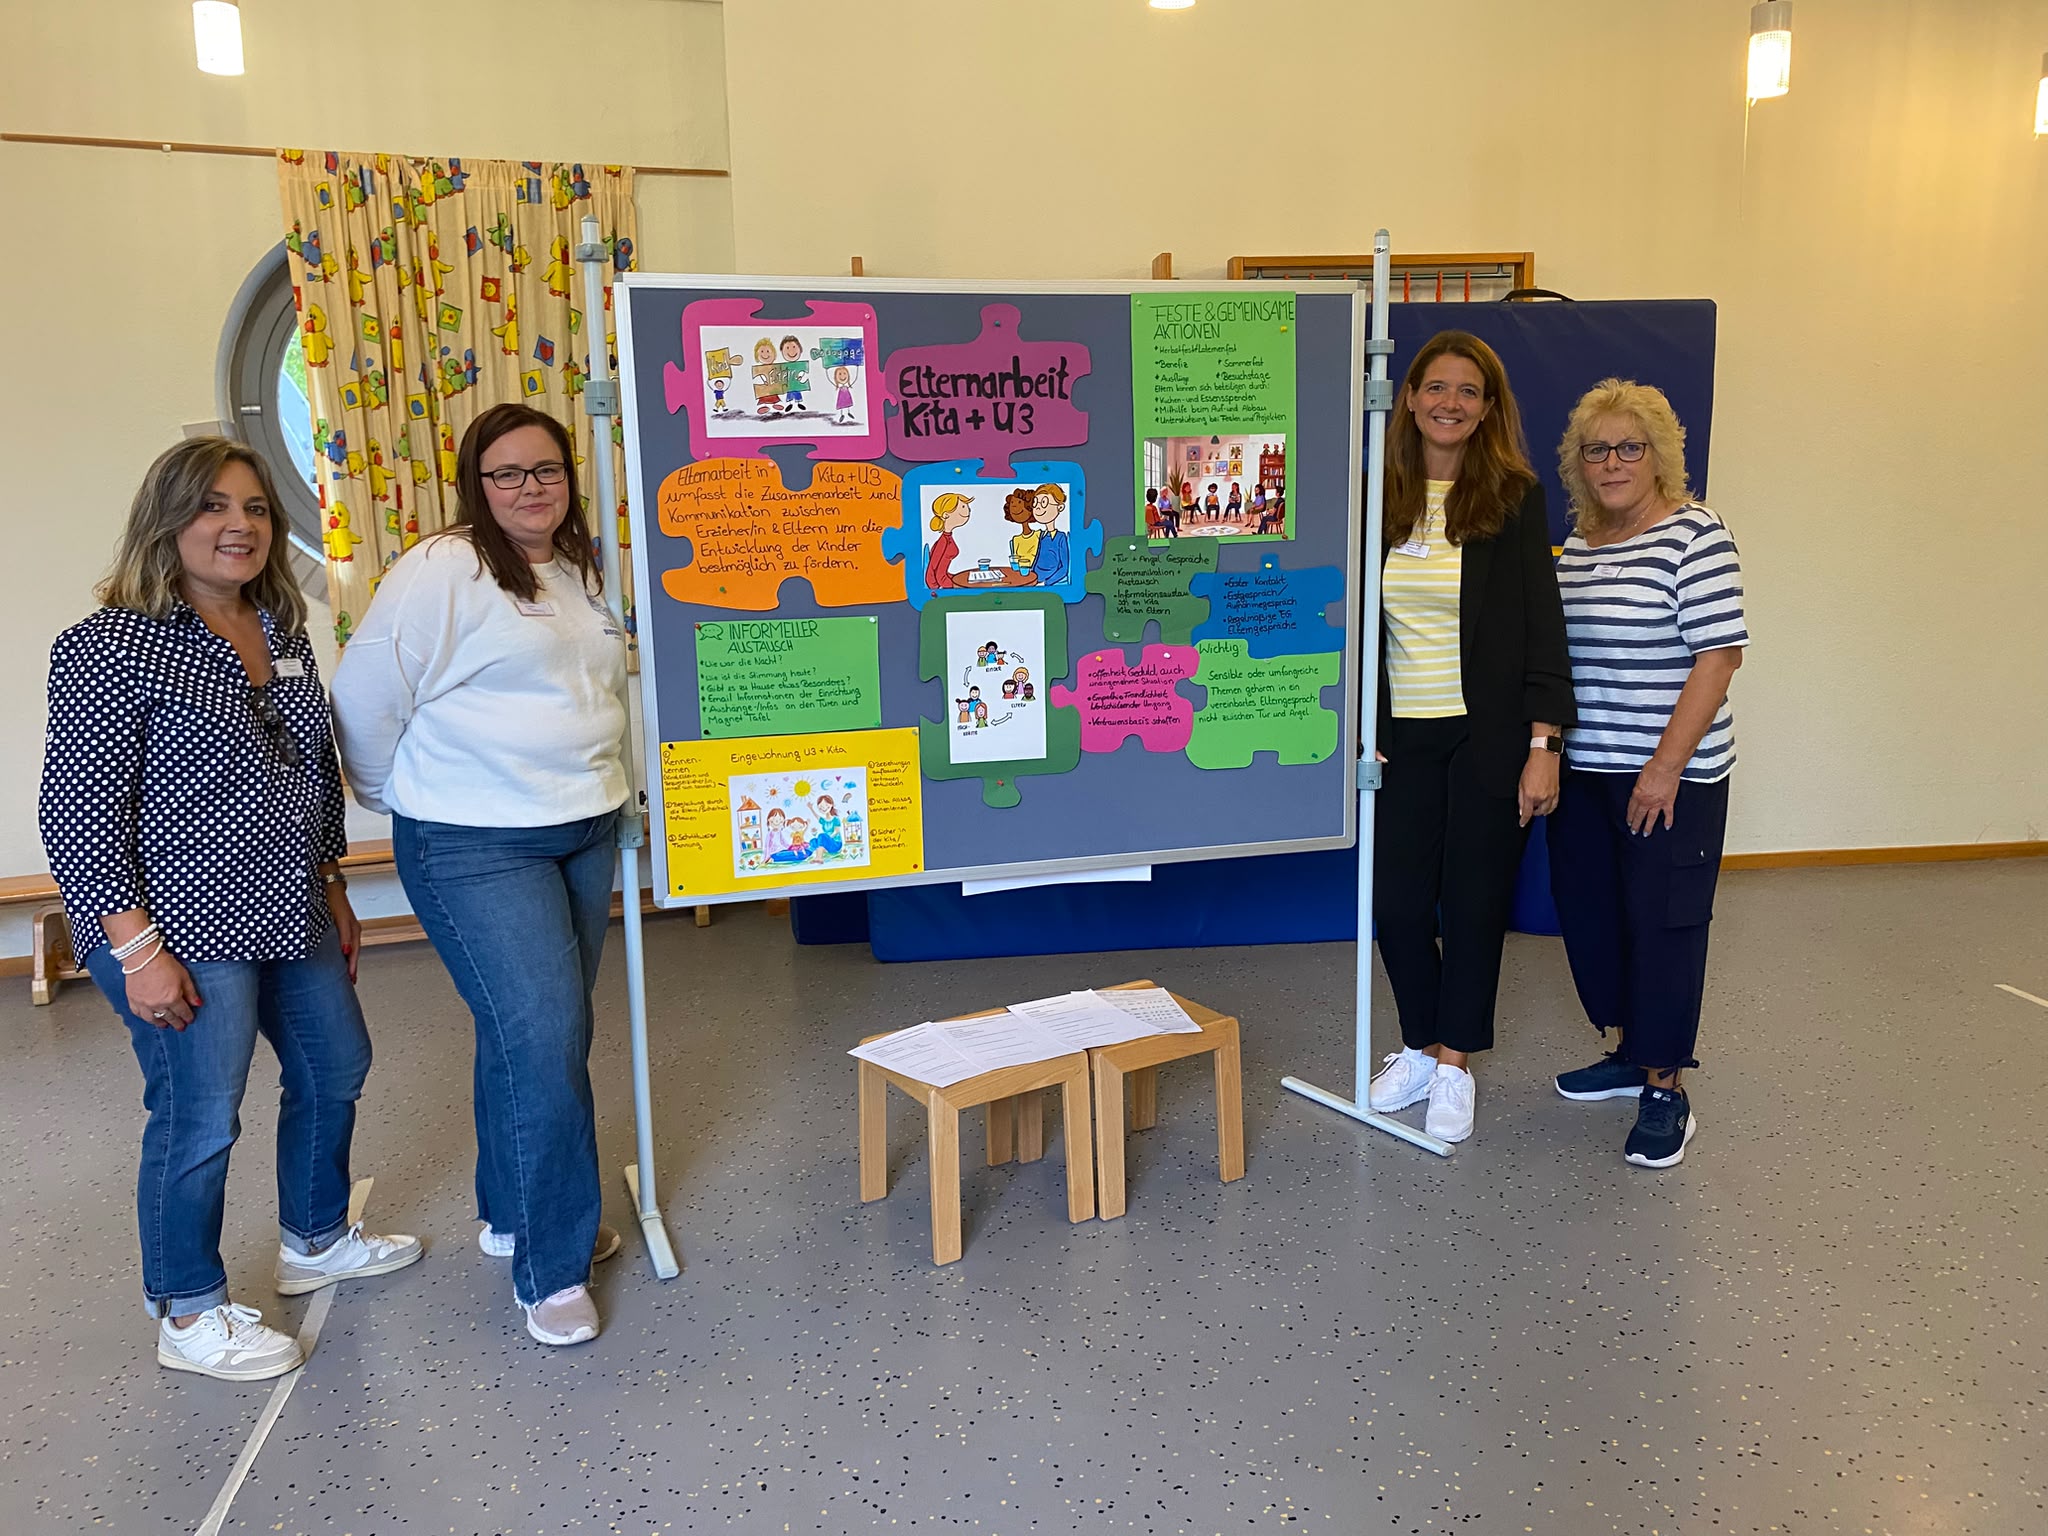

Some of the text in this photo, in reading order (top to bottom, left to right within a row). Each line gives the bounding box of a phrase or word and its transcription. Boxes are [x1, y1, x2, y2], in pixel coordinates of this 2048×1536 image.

[1150, 304, 1202, 322] FESTE
[1216, 301, 1294, 321] GEMEINSAME
[1154, 323, 1220, 340] AKTIONEN
[1224, 356, 1264, 367] Sommerfest
[900, 356, 1069, 399] Elternarbeit
[1221, 370, 1271, 386] Besuchstage
[1214, 381, 1246, 392] beteiligen
[1201, 394, 1256, 404] Essensspenden
[1192, 404, 1208, 413] beim
[902, 400, 1034, 437] Kita + U3
[1254, 413, 1287, 425] Projekten
[678, 463, 751, 486] Elternarbeit
[756, 464, 768, 477] in
[817, 467, 845, 483] Kita
[665, 485, 900, 507] umfasst die Zusammenarbeit und
[667, 505, 840, 523] Kommunikation zwischen
[696, 519, 883, 539] Erzieher/in & Eltern um die
[701, 537, 861, 560] Entwicklung der Kinder
[697, 556, 859, 576] bestmöglich zu fördern.
[1117, 568, 1174, 576] Kommunikation
[1255, 576, 1286, 585] Kontakt
[729, 620, 820, 640] INFORMELLER
[728, 640, 793, 654] AUSTAUSCH
[738, 658, 751, 667] die
[1161, 664, 1184, 675] auch
[749, 668, 787, 681] Stimmung
[790, 667, 816, 677] heute?
[1208, 665, 1319, 680] Sensible oder umfangreiche
[706, 684, 724, 692] Gibt
[751, 682, 775, 691] Hause
[779, 680, 799, 689] etwas
[1210, 686, 1241, 695] Themen
[708, 694, 732, 702] Email
[737, 691, 794, 701] Informationen
[818, 687, 862, 699] Einrichtung
[799, 700, 815, 709] den
[842, 698, 859, 706] und
[1210, 698, 1256, 709] vereinbartes
[708, 713, 770, 726] Magnet Tafel
[1151, 716, 1180, 725] schaffen
[1199, 715, 1217, 723] nicht
[1222, 711, 1254, 721] zwischen
[1273, 709, 1286, 717] und
[827, 746, 847, 754] Kita
